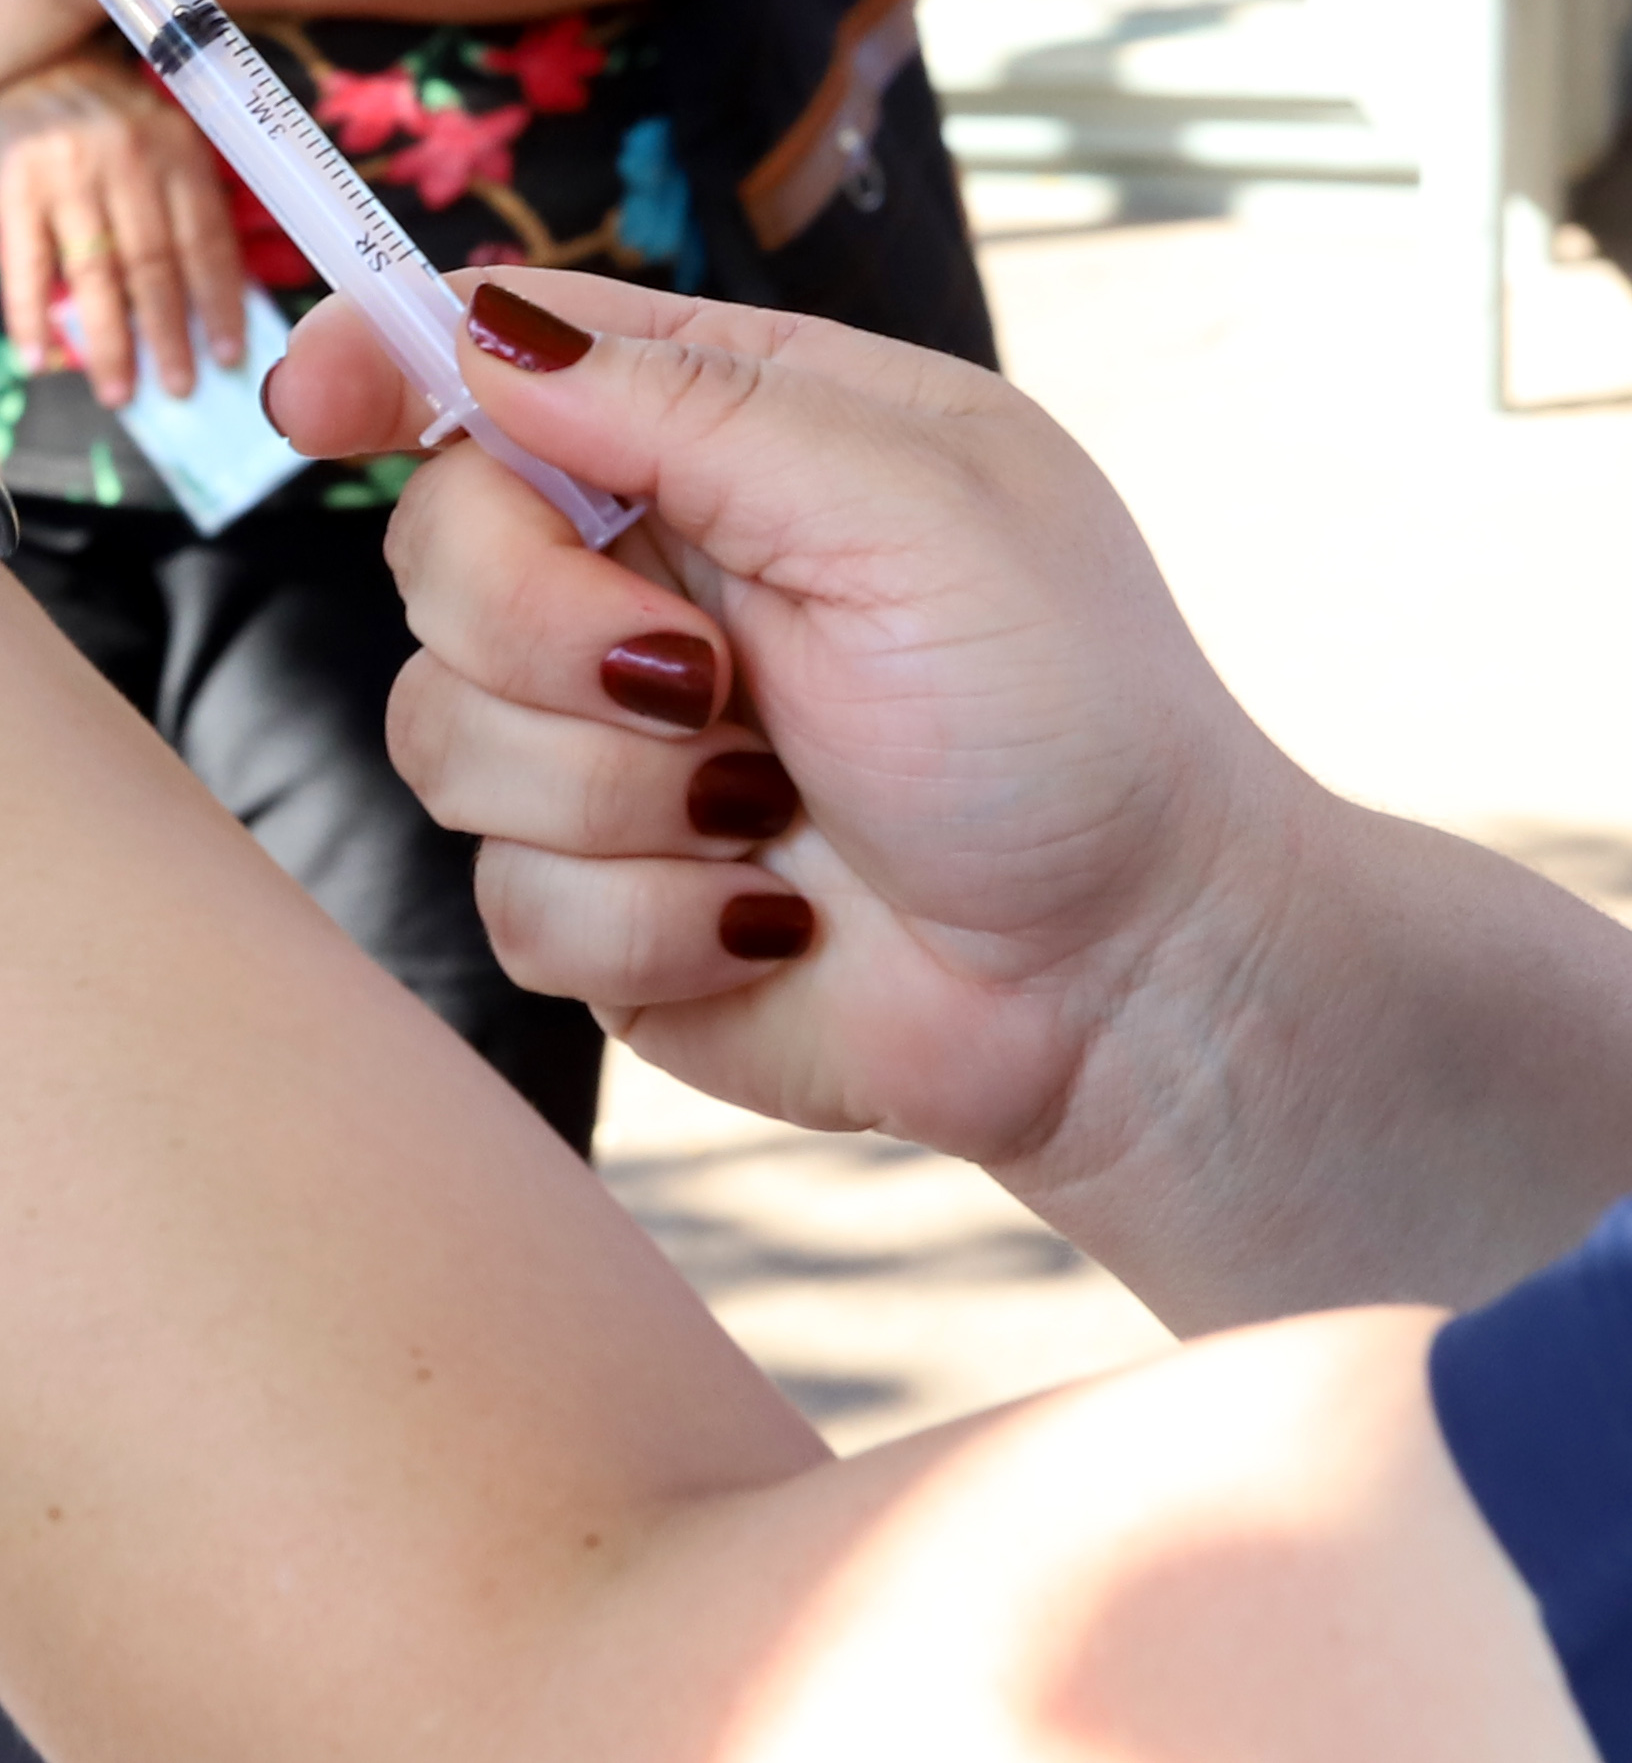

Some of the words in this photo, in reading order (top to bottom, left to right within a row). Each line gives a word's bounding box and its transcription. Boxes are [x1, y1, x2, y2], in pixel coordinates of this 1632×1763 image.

[245, 89, 274, 125] ML
[268, 123, 287, 140] 3
[355, 231, 392, 272] SR
